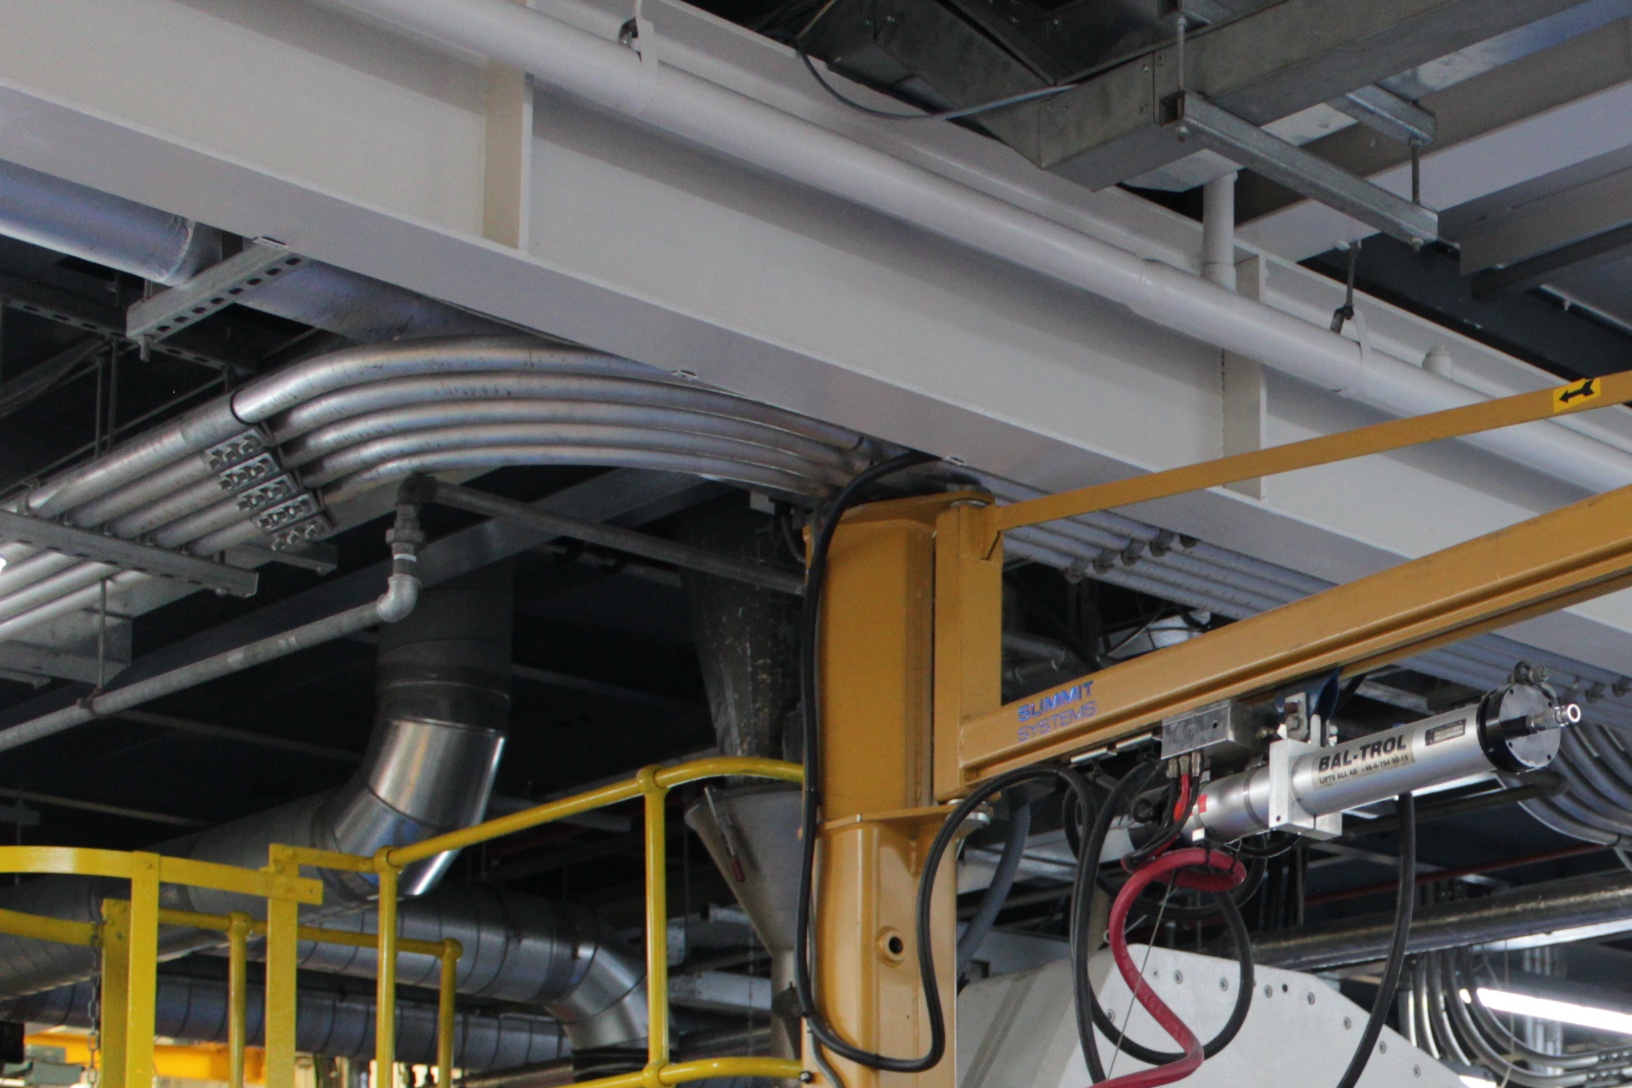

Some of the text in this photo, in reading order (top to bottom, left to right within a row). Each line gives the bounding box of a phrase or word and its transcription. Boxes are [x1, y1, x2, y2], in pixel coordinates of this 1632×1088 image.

[1018, 680, 1094, 722] SUMMIT
[1018, 700, 1096, 742] SYSTEMS
[1318, 734, 1407, 773] BAL-TROL
[1320, 774, 1336, 784] LIFTS
[1337, 771, 1348, 780] ALL
[1349, 768, 1358, 776] AB
